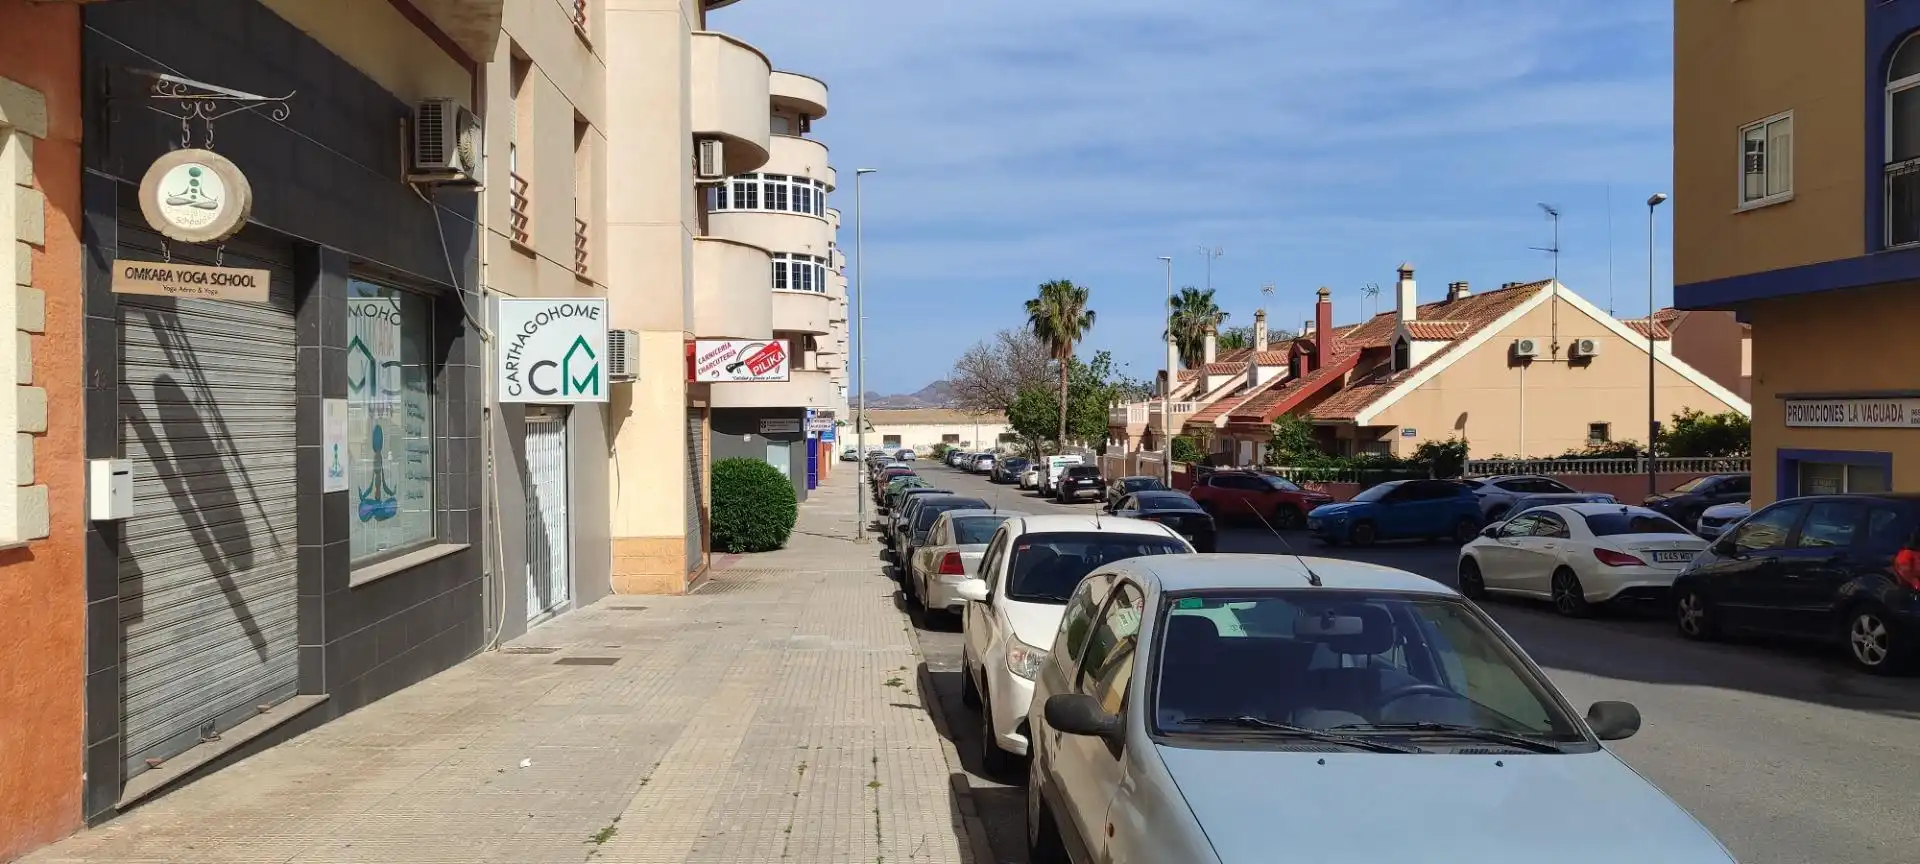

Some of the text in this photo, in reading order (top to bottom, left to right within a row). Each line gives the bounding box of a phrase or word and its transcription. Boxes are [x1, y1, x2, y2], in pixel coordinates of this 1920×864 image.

[125, 266, 256, 288] OMKARA YOGA SCHOOL
[163, 284, 177, 294] Yoga
[204, 287, 218, 296] Yoga
[506, 304, 600, 396] CARTHAGOHOME
[752, 351, 785, 375] PILIKA
[1787, 403, 1904, 422] PROMOCIONES LA VAGUADA
